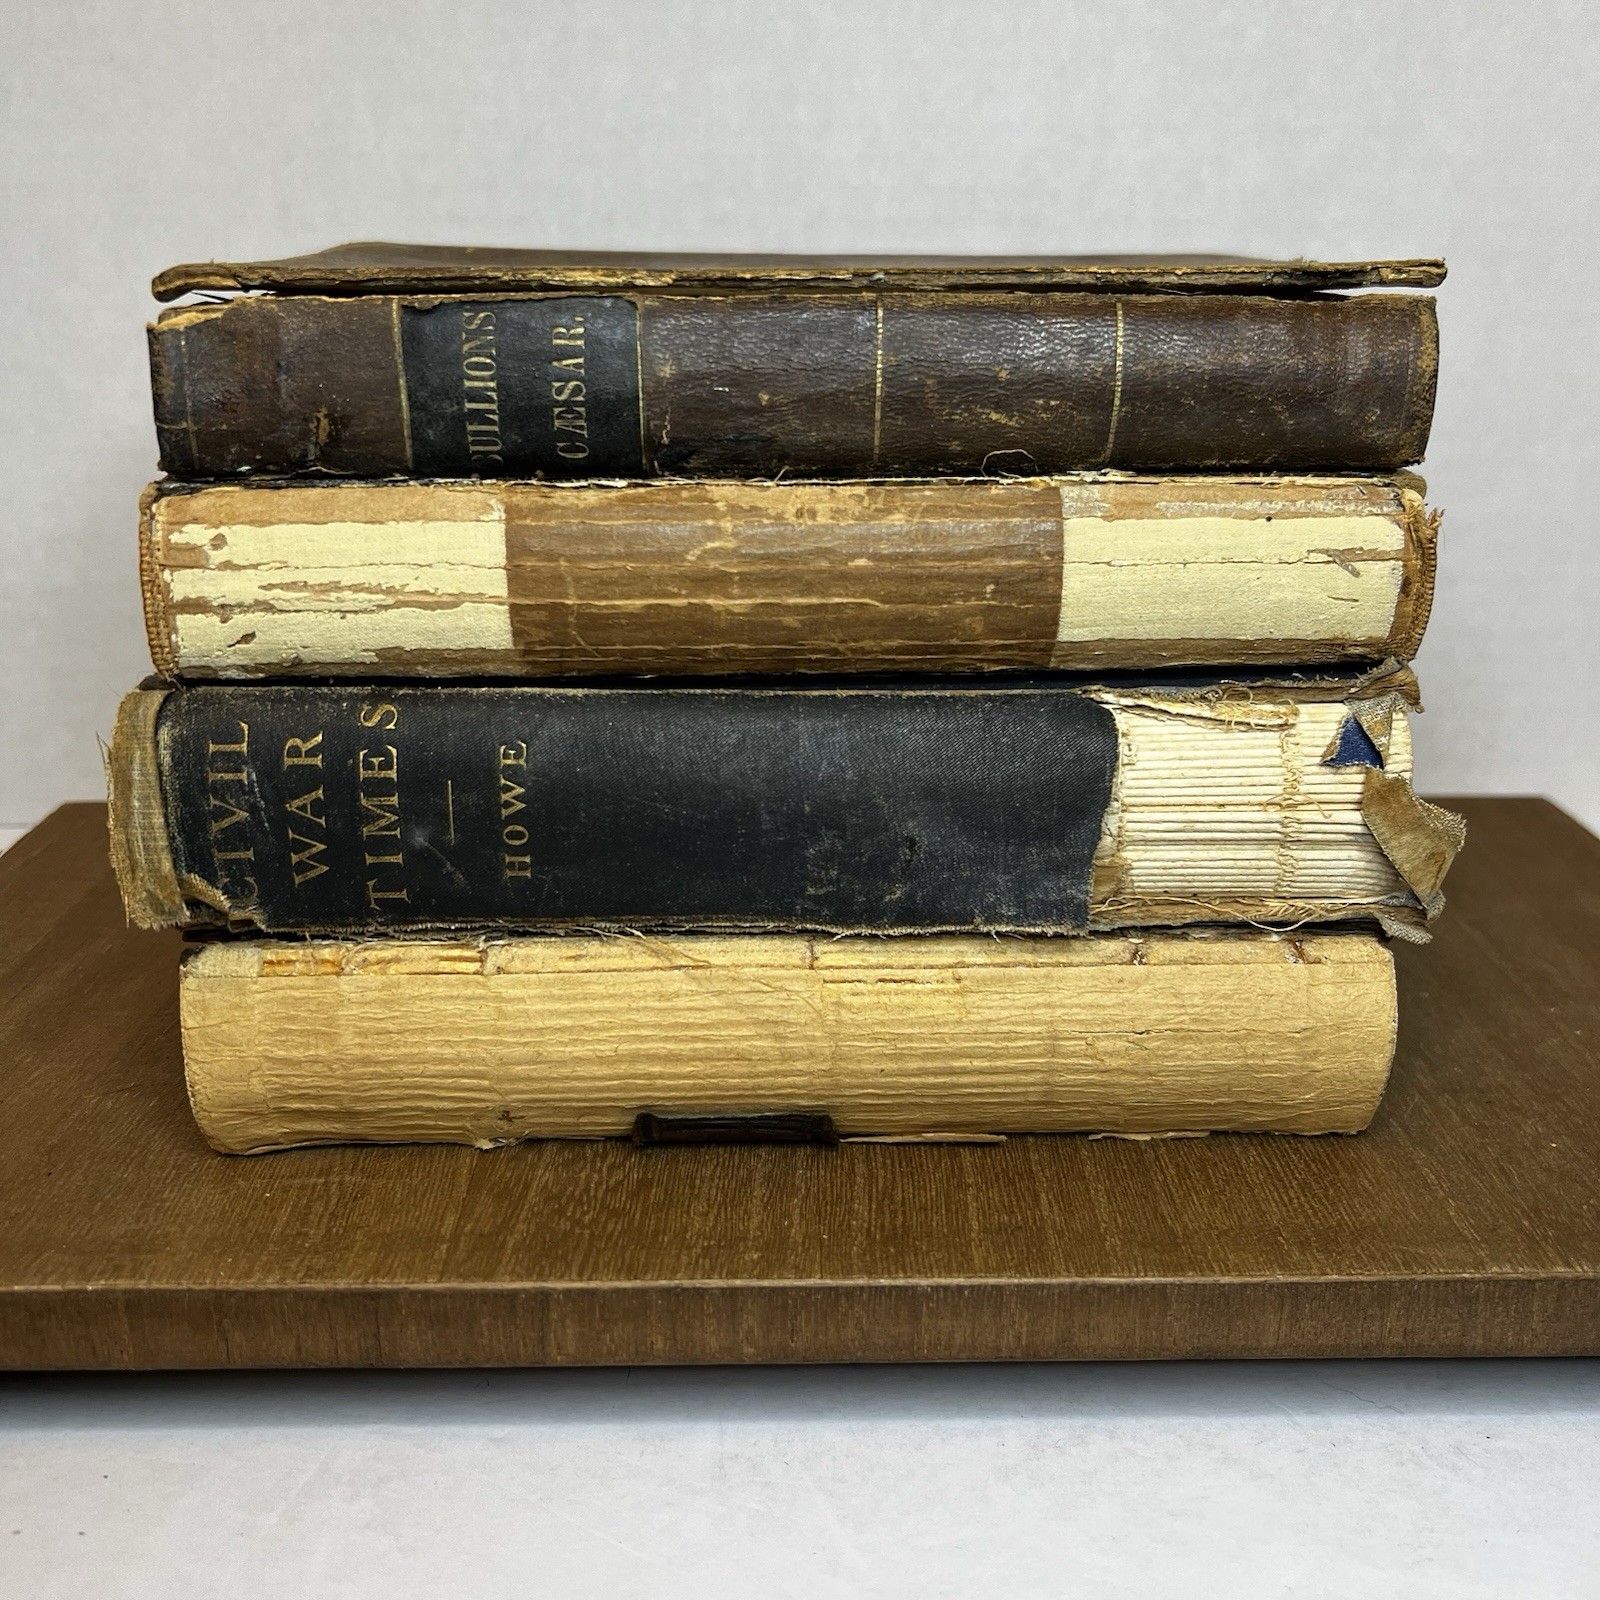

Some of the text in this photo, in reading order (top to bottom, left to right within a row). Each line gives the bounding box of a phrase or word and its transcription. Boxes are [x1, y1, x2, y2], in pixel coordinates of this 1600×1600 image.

[552, 316, 589, 459] CÆSAR.
[208, 720, 259, 905] CIVIL
[284, 730, 330, 888] WAR
[359, 704, 411, 911] TIMES
[500, 740, 532, 879] HOWE
